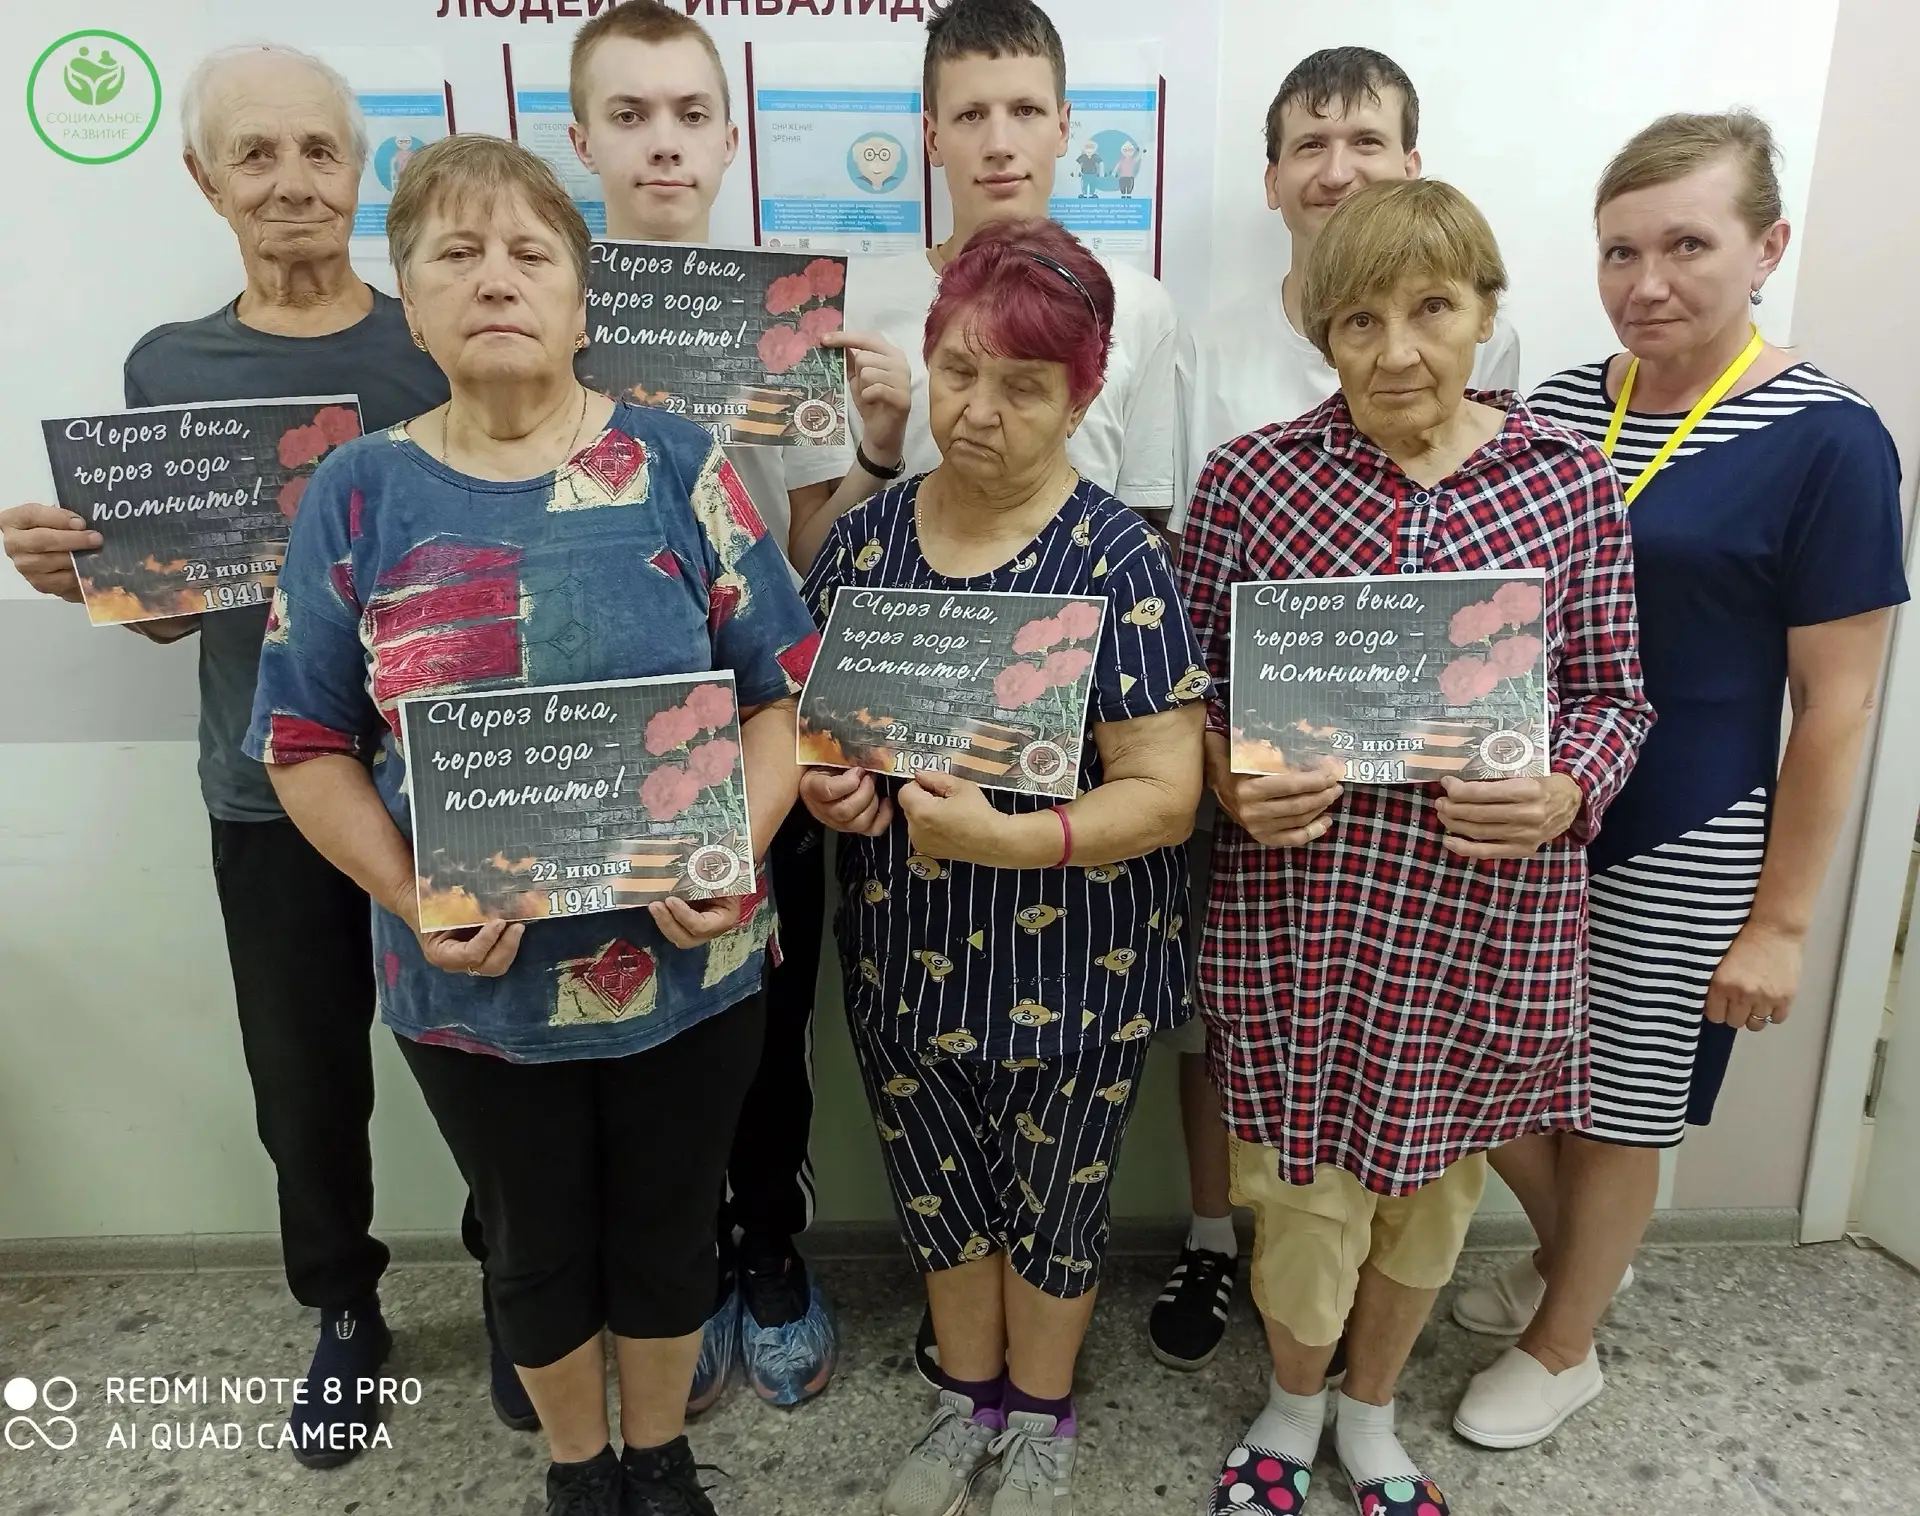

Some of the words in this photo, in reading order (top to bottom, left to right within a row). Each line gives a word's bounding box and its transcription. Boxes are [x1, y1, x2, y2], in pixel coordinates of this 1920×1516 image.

[686, 0, 948, 23] ИНВАЛИД
[772, 123, 813, 131] СНИЖЕНИЕ
[588, 244, 673, 281] Через
[683, 250, 747, 281] века,
[586, 288, 654, 317] через
[664, 293, 723, 319] года
[594, 321, 747, 349] помните!
[664, 398, 687, 414] 22
[693, 402, 748, 416] июня
[65, 418, 167, 453] Через
[180, 411, 251, 439] века,
[707, 423, 734, 444] 41
[74, 461, 153, 491] через
[164, 456, 232, 481] года
[92, 476, 263, 523] помните!
[183, 564, 211, 582] 22
[215, 559, 278, 578] июня
[203, 582, 266, 610] 1941
[852, 591, 930, 619] Через
[939, 596, 999, 625] века,
[1254, 585, 1345, 619] Через
[1356, 584, 1426, 614] века,
[842, 627, 905, 651] через
[911, 633, 970, 655] года
[1253, 628, 1324, 655] через
[1335, 628, 1399, 654] года
[836, 655, 990, 682] помните!
[1259, 654, 1428, 684] помните!
[428, 701, 531, 737] Через
[544, 694, 619, 724] века,
[884, 724, 909, 742] 22
[914, 732, 973, 750] июня
[1330, 733, 1355, 750] 22
[1361, 736, 1424, 752] июня
[432, 748, 513, 779] через
[524, 742, 594, 771] года
[893, 751, 952, 774] 1941
[1344, 759, 1407, 783] 1941
[445, 766, 627, 811] помните!
[531, 863, 561, 883] 22
[565, 859, 633, 880] июня
[548, 886, 617, 916] 1941
